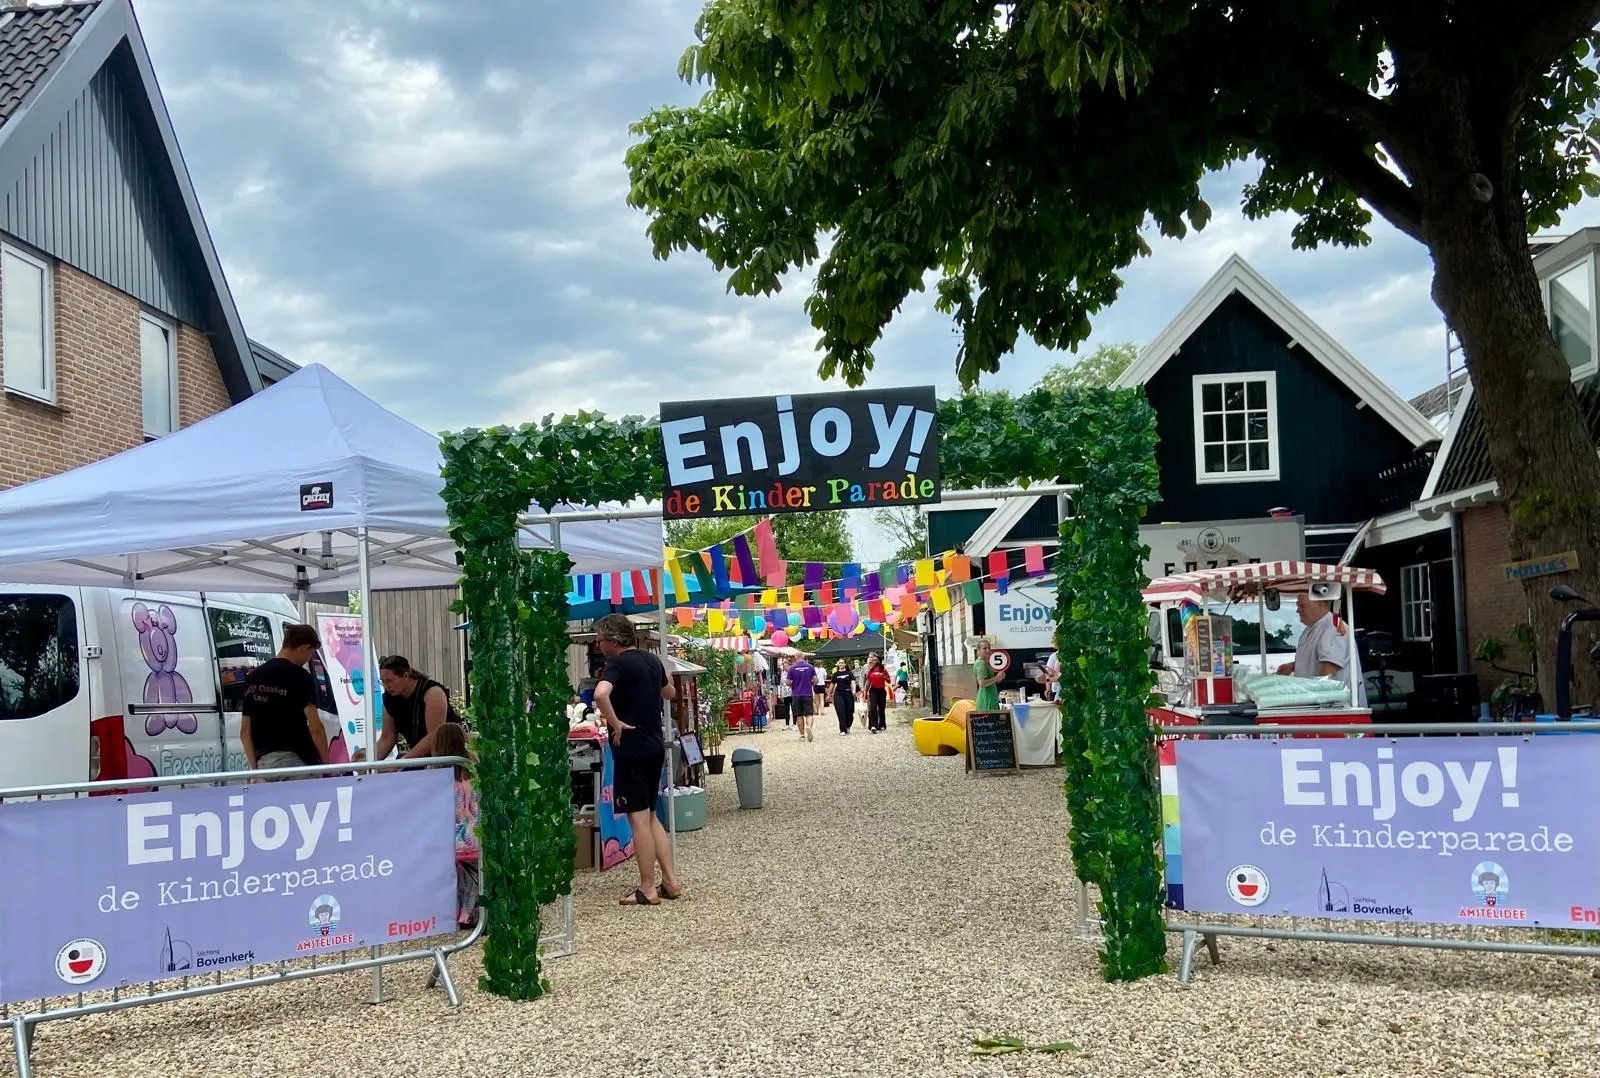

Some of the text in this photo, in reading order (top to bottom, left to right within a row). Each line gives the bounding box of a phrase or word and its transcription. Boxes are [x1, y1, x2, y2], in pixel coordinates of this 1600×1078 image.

[660, 395, 934, 487] Enjoy!
[666, 473, 935, 516] de Kinder Parade
[999, 603, 1055, 625] Enjoy
[1010, 625, 1053, 633] childcare
[993, 654, 1004, 667] 5
[1280, 746, 1520, 822] Enjoy!
[127, 786, 353, 870] Enjoy!
[1260, 822, 1574, 856] de Kinderparade
[98, 855, 393, 914] de Kinderparade
[1353, 903, 1413, 916] Bovenkerk
[1459, 906, 1527, 920] AMSTELIDEE
[387, 916, 437, 937] Enjoy!
[296, 933, 354, 951] AMSTELIDEE
[196, 950, 255, 968] Bovenkerk
